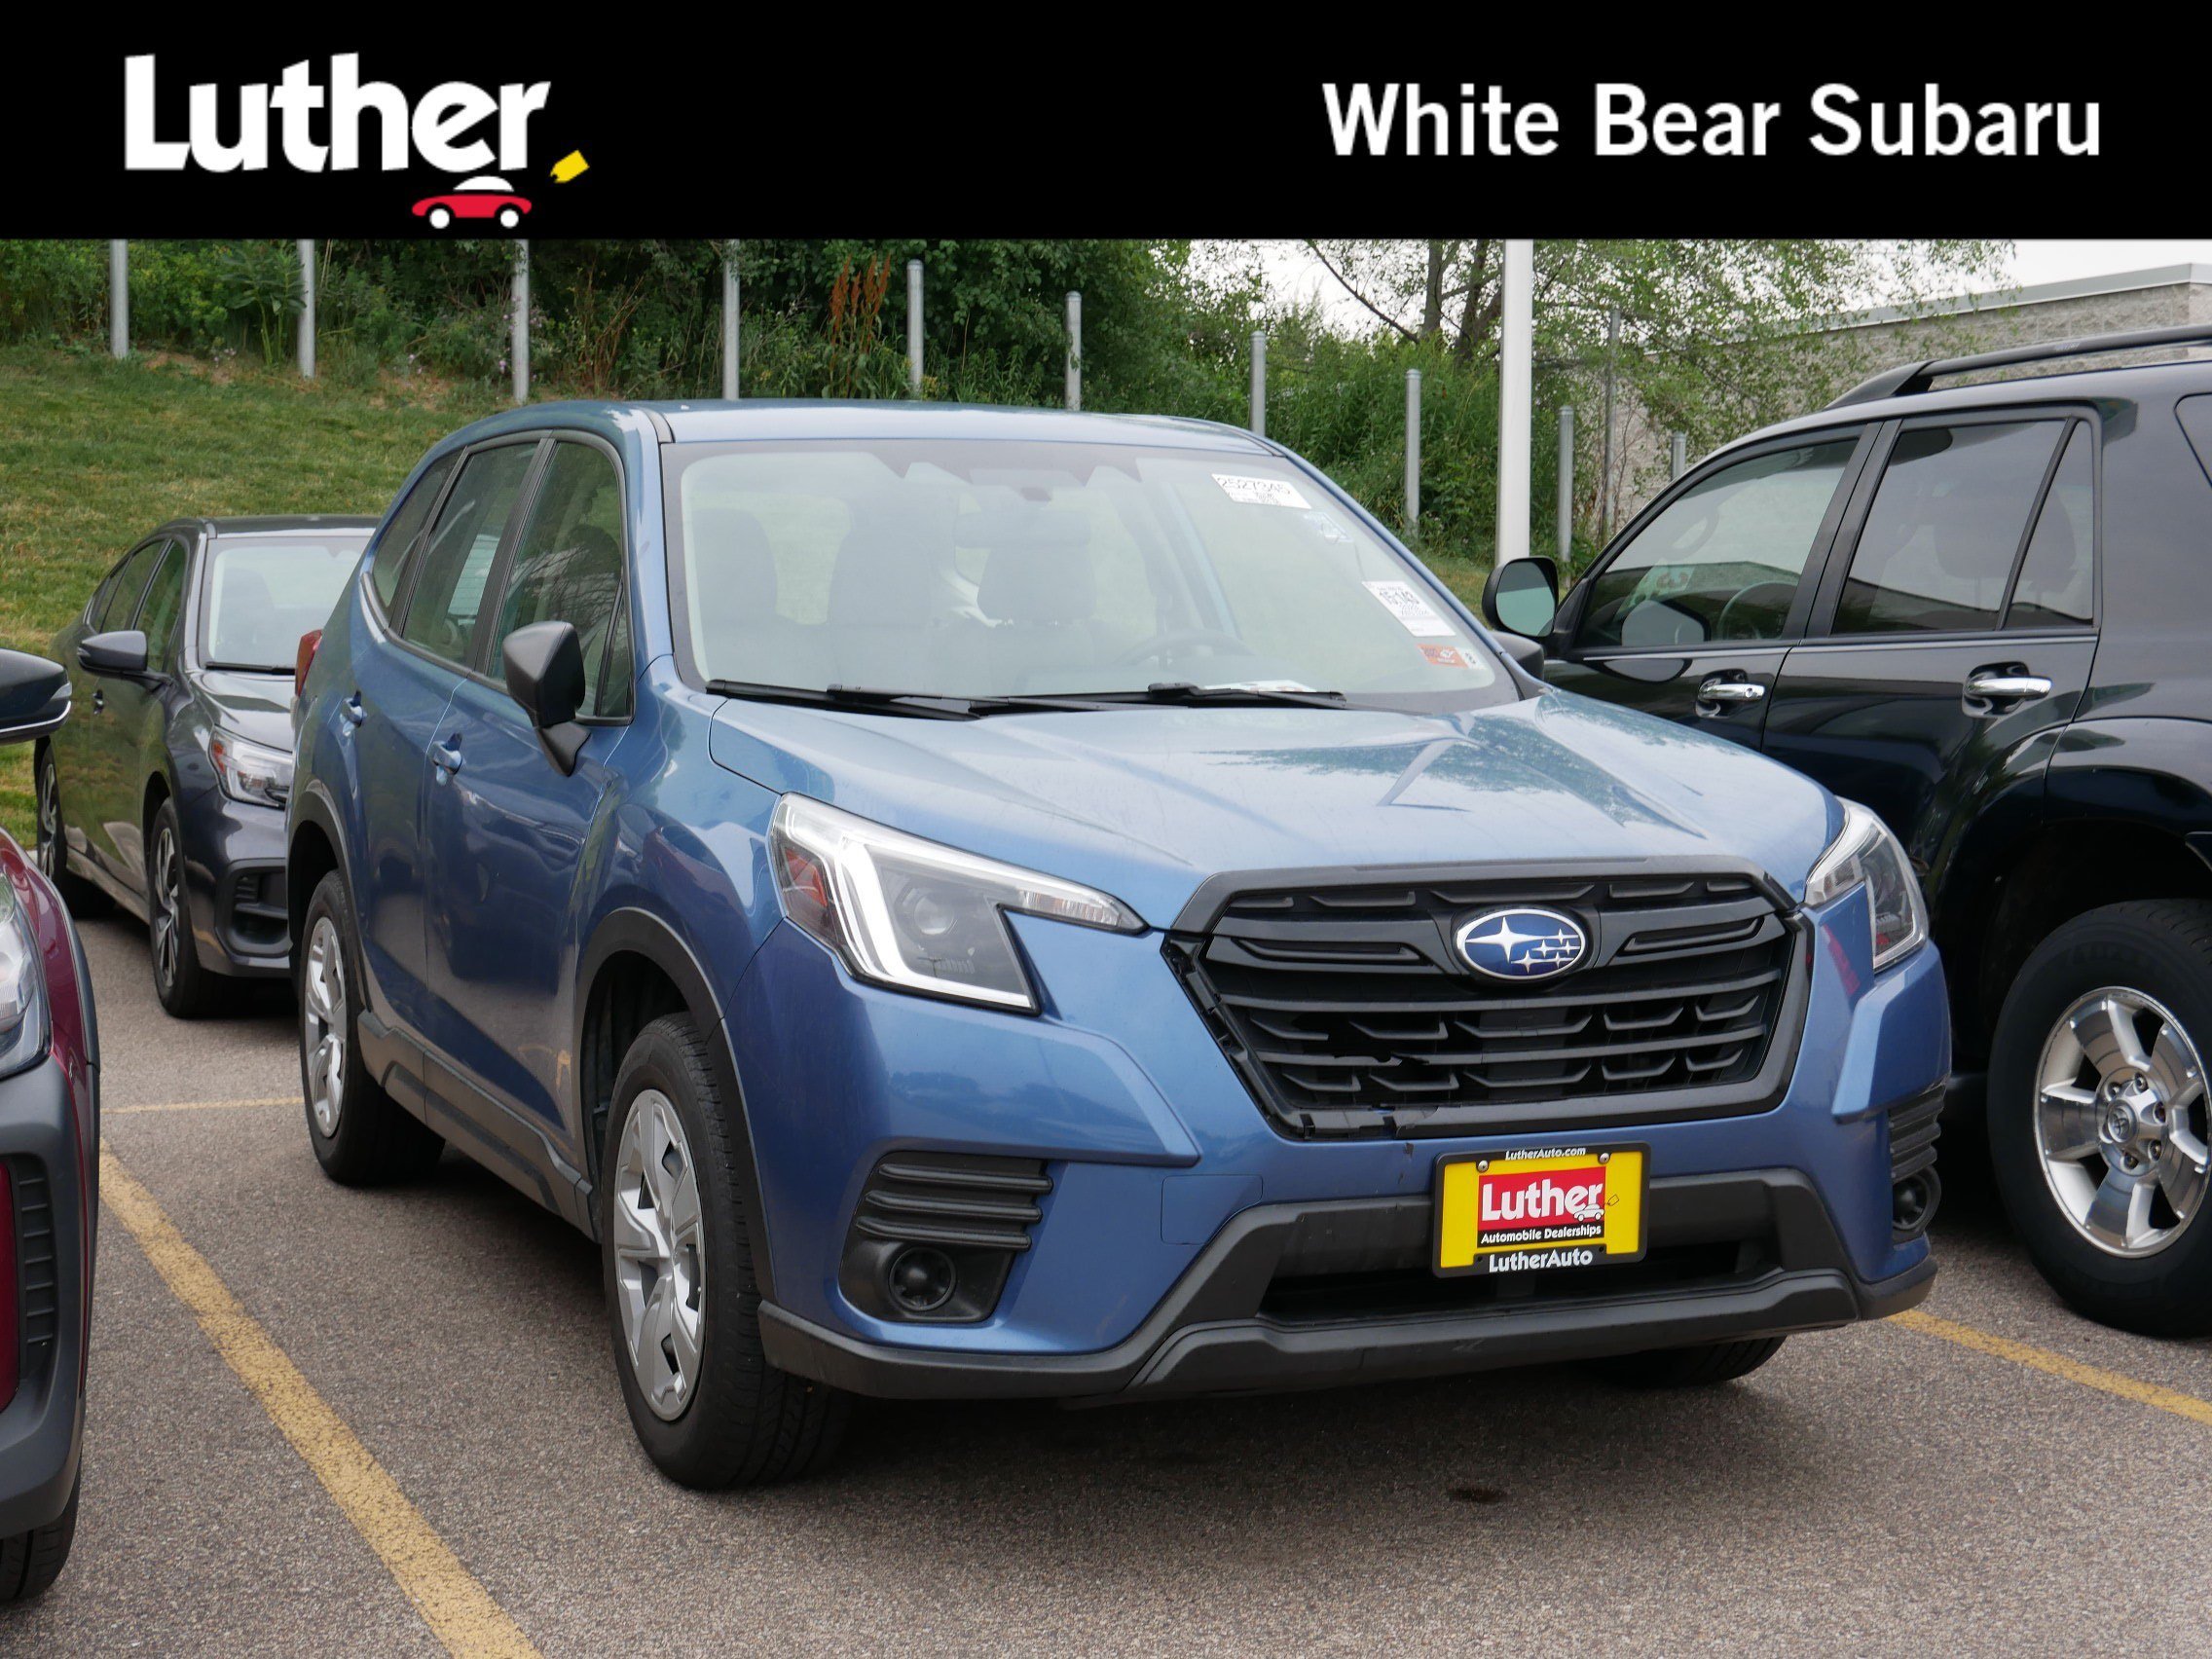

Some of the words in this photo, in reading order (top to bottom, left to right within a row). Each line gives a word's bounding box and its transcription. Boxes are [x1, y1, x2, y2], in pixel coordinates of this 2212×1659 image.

[1505, 1147, 1586, 1161] LutherAuto.com
[1482, 1179, 1604, 1221] Luther
[1481, 1230, 1542, 1243] Automobile
[1544, 1224, 1602, 1238] Dealerships
[1489, 1247, 1593, 1272] LutherAuto
